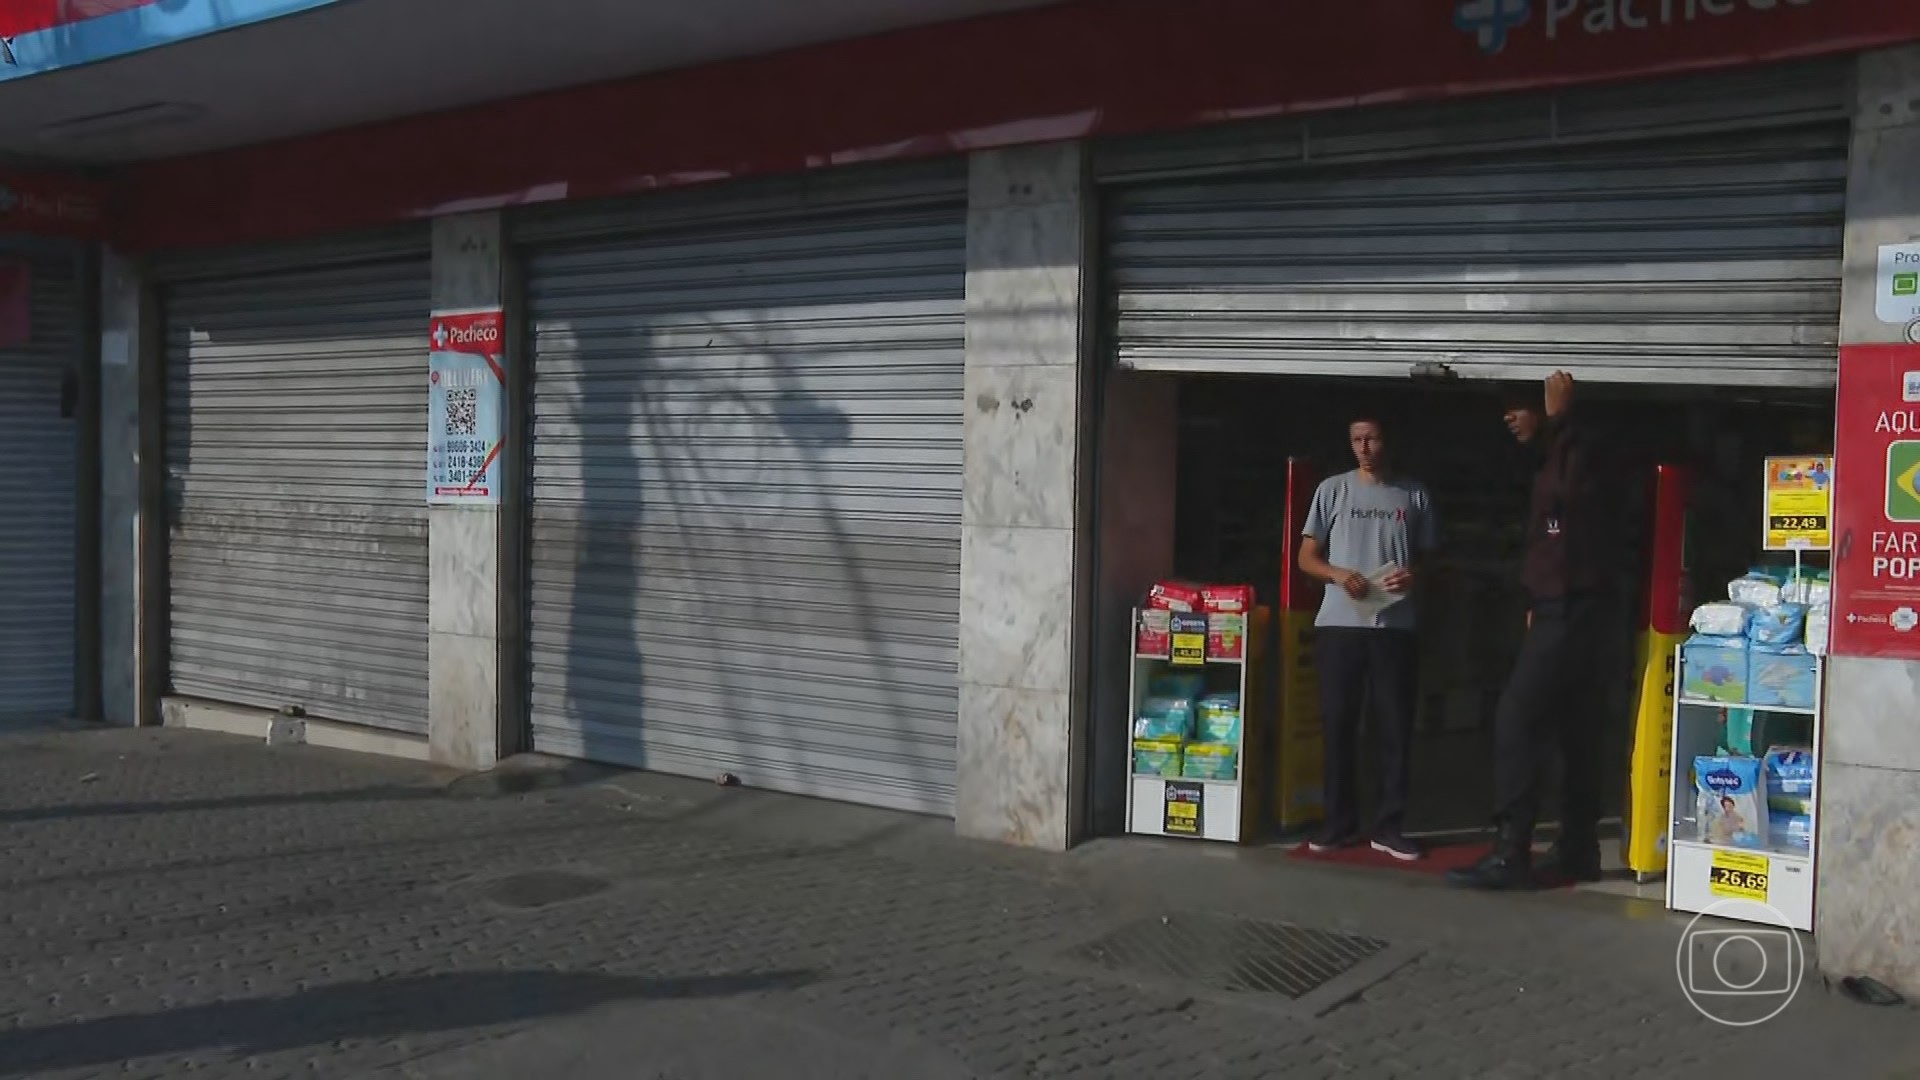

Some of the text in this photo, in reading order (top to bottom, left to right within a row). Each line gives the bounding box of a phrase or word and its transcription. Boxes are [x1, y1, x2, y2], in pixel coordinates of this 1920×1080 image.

[1545, 0, 1812, 40] Pach
[450, 325, 498, 344] Pacheco
[1351, 507, 1393, 519] Hurley
[1782, 517, 1817, 531] 22,49
[1872, 531, 1917, 553] FAR
[1873, 557, 1920, 579] POP
[1720, 869, 1767, 890] 26,69
